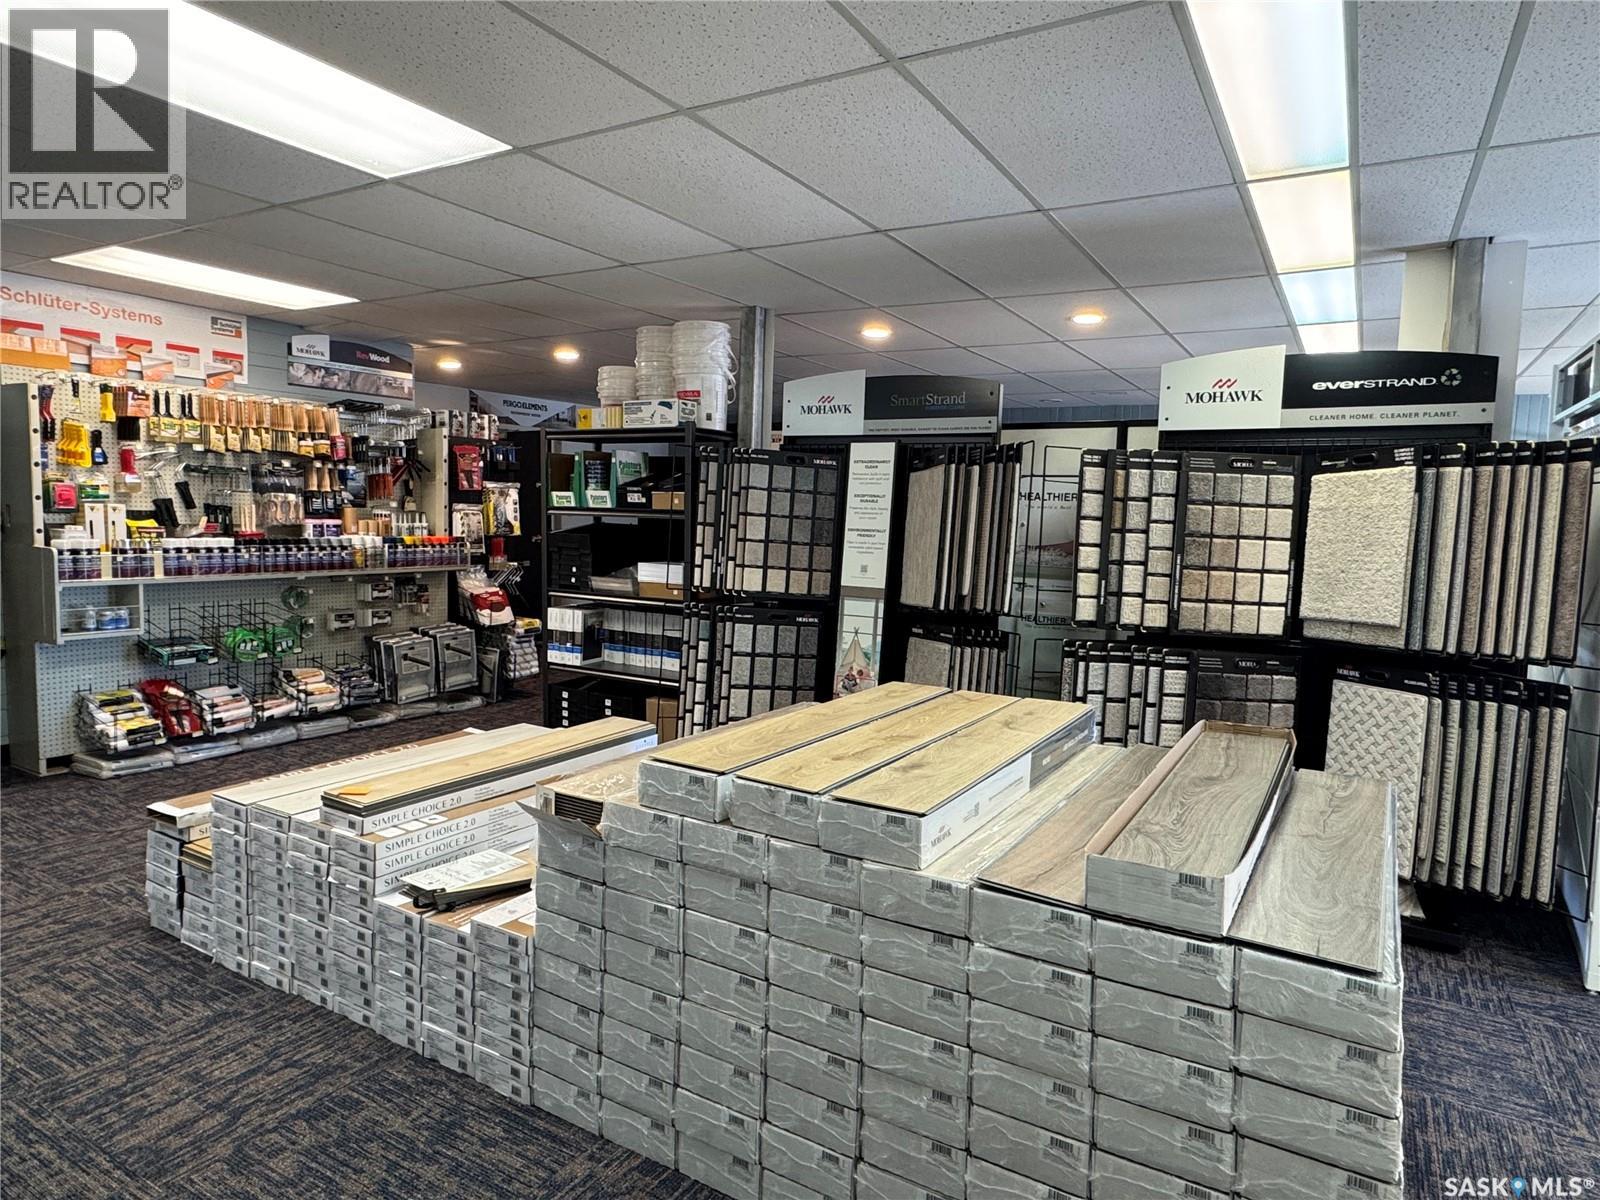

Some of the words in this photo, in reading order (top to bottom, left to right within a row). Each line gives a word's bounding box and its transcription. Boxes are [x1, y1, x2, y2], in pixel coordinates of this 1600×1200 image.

[0, 286, 163, 326] Schlüter-Systems
[355, 350, 391, 364] RevWood
[890, 391, 967, 408] SmartStrand
[1184, 389, 1264, 404] MOHAWK
[800, 404, 852, 416] MOHAWK
[1309, 413, 1347, 422] CLEANER
[1380, 412, 1420, 420] CLEANER
[1422, 410, 1461, 418] PLANET.
[371, 810, 408, 829] SIMPLE
[411, 800, 448, 818] CHOICE
[449, 795, 463, 806] 2.0
[385, 836, 423, 853] SIMPLE
[425, 822, 462, 841] CHOICE
[463, 817, 477, 828] 2.0
[384, 852, 422, 870] SIMPLE
[424, 838, 462, 856] CHOICE
[463, 833, 476, 844] 2.0
